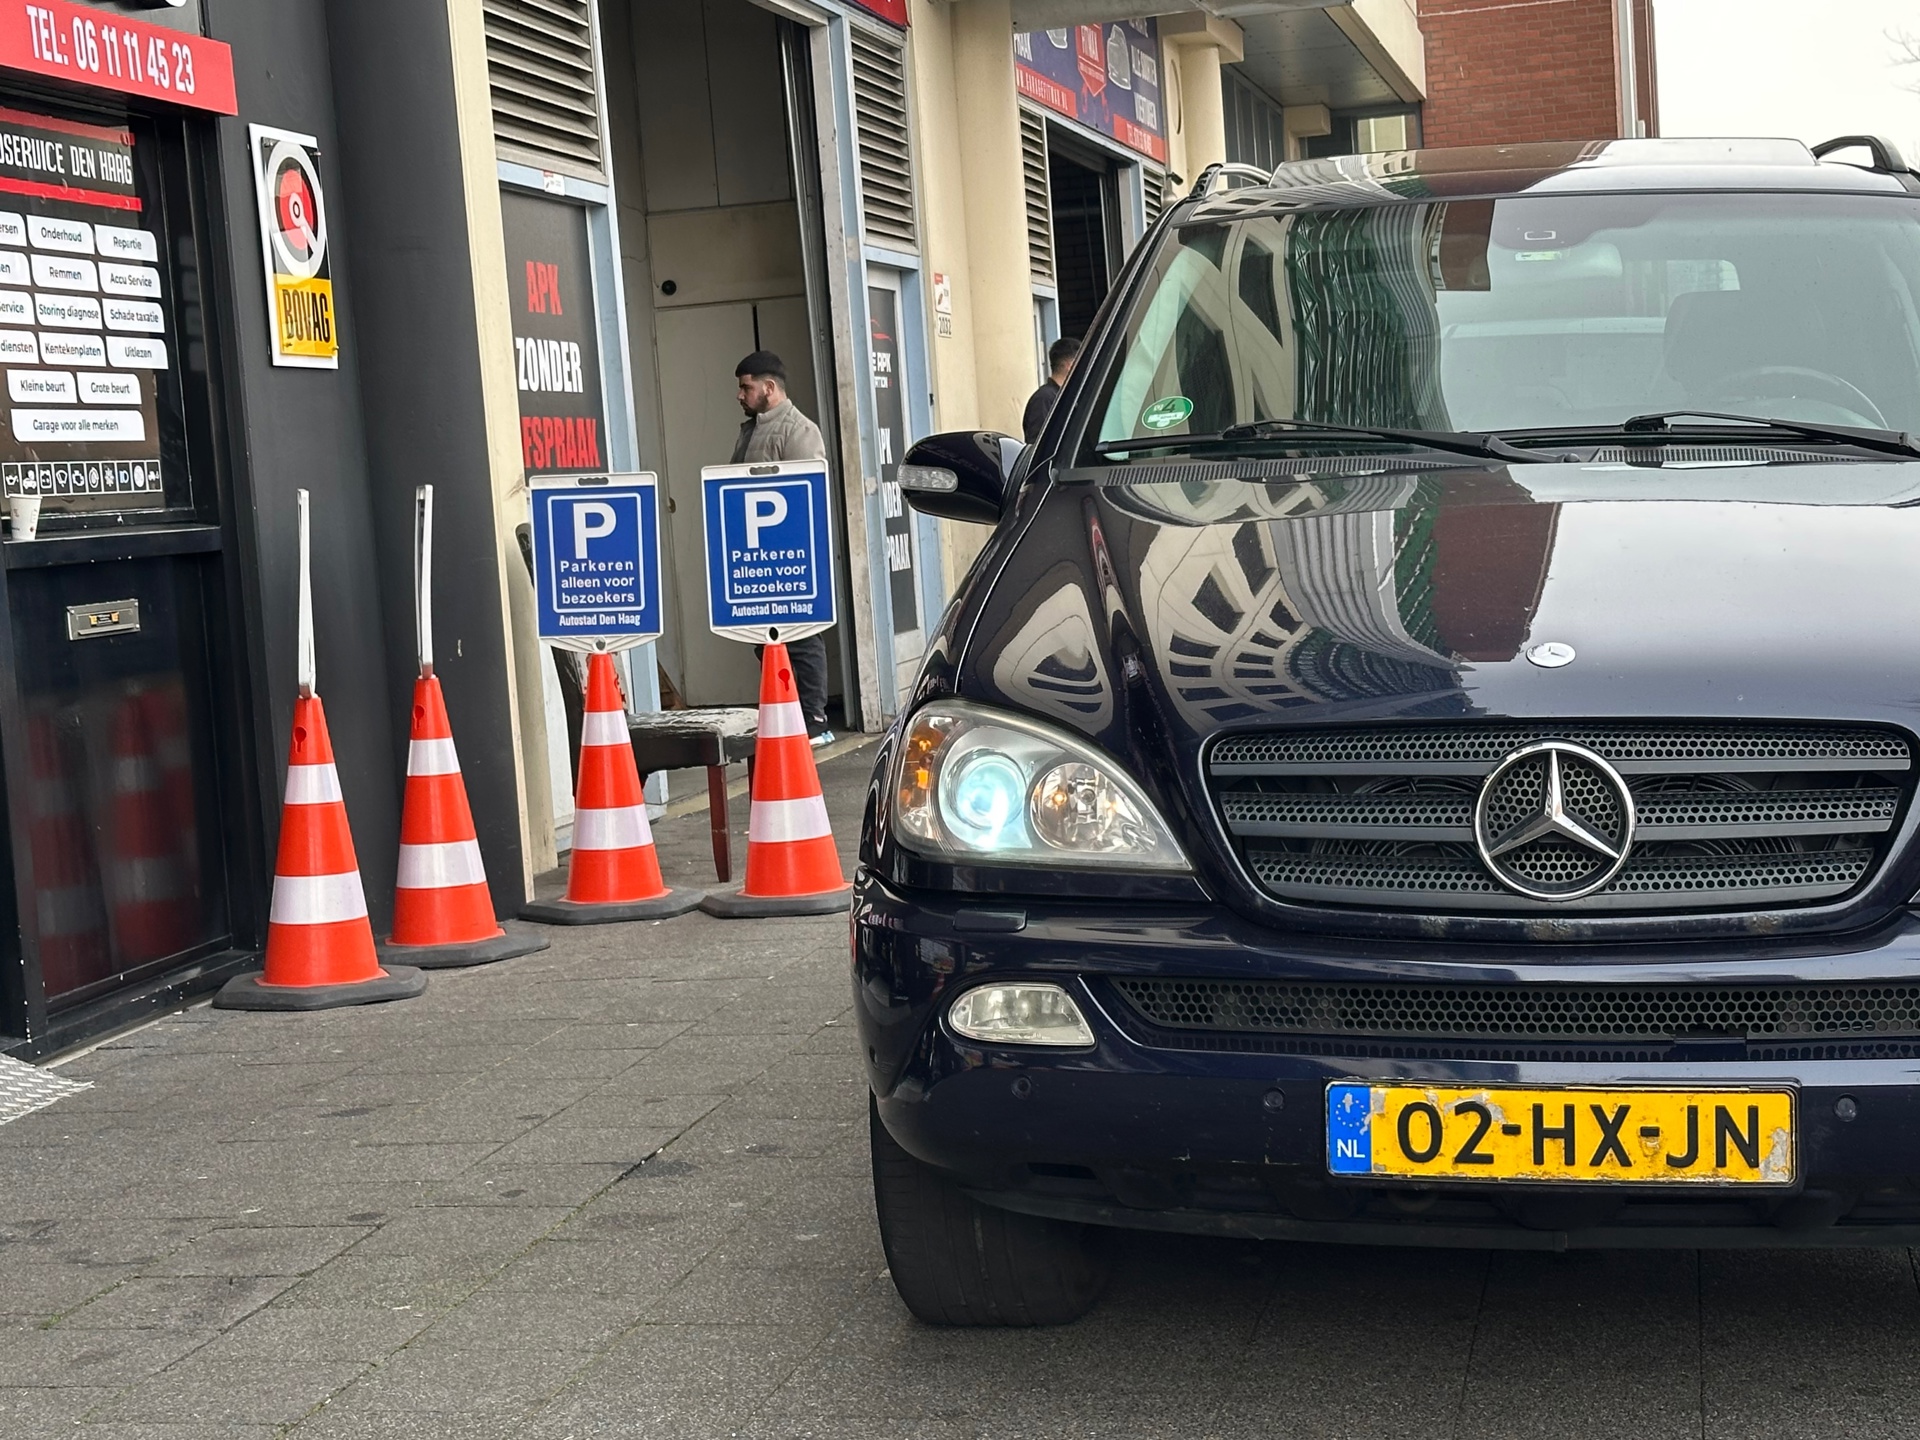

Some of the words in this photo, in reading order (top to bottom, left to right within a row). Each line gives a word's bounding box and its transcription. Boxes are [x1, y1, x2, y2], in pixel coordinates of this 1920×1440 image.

[26, 5, 69, 65] TEL:
[72, 16, 99, 73] 06
[101, 24, 121, 77] 11
[123, 30, 143, 82] 11
[147, 36, 169, 89] 45
[172, 42, 195, 94] 23
[70, 145, 97, 179] DEN
[99, 151, 133, 184] HAAG
[41, 227, 82, 242] Onderhoud
[49, 267, 82, 281] Remmen
[110, 273, 127, 285] Accu
[128, 274, 152, 288] Service
[526, 260, 563, 315] APK
[39, 304, 66, 319] Storing
[67, 304, 99, 320] diagnose
[110, 308, 135, 321] Schade
[136, 311, 159, 323] taxatie
[282, 289, 331, 343] BOVAG
[0, 340, 34, 354] diensten
[45, 343, 102, 358] Kentekenplaten
[125, 346, 152, 358] Uitlezen
[515, 337, 583, 393] ZONDER
[20, 379, 44, 392] Kleine
[46, 381, 66, 393] beurt
[91, 382, 110, 394] Grote
[111, 383, 130, 394] beurt
[33, 419, 60, 433] Garage
[61, 422, 77, 431] voor
[78, 419, 91, 431] alle
[92, 419, 119, 431] merken
[521, 416, 601, 469] FSPRAAK
[744, 490, 788, 549] P
[573, 503, 617, 559] P
[732, 549, 806, 562] Parkeren
[560, 560, 634, 573] Parkeren
[733, 566, 772, 578] alleen
[776, 564, 806, 576] voor
[561, 576, 600, 588] alleen
[604, 576, 635, 587] voor
[734, 580, 807, 595] bezoekers
[562, 592, 635, 605] bezoekers
[732, 603, 769, 617] Autostad
[772, 603, 789, 615] Den
[791, 601, 813, 615] Haag
[559, 614, 597, 627] Autostad
[600, 613, 616, 625] Den
[618, 612, 641, 626] Haag
[1397, 1100, 1760, 1168] 02-HX-JN
[1337, 1139, 1365, 1159] NL
